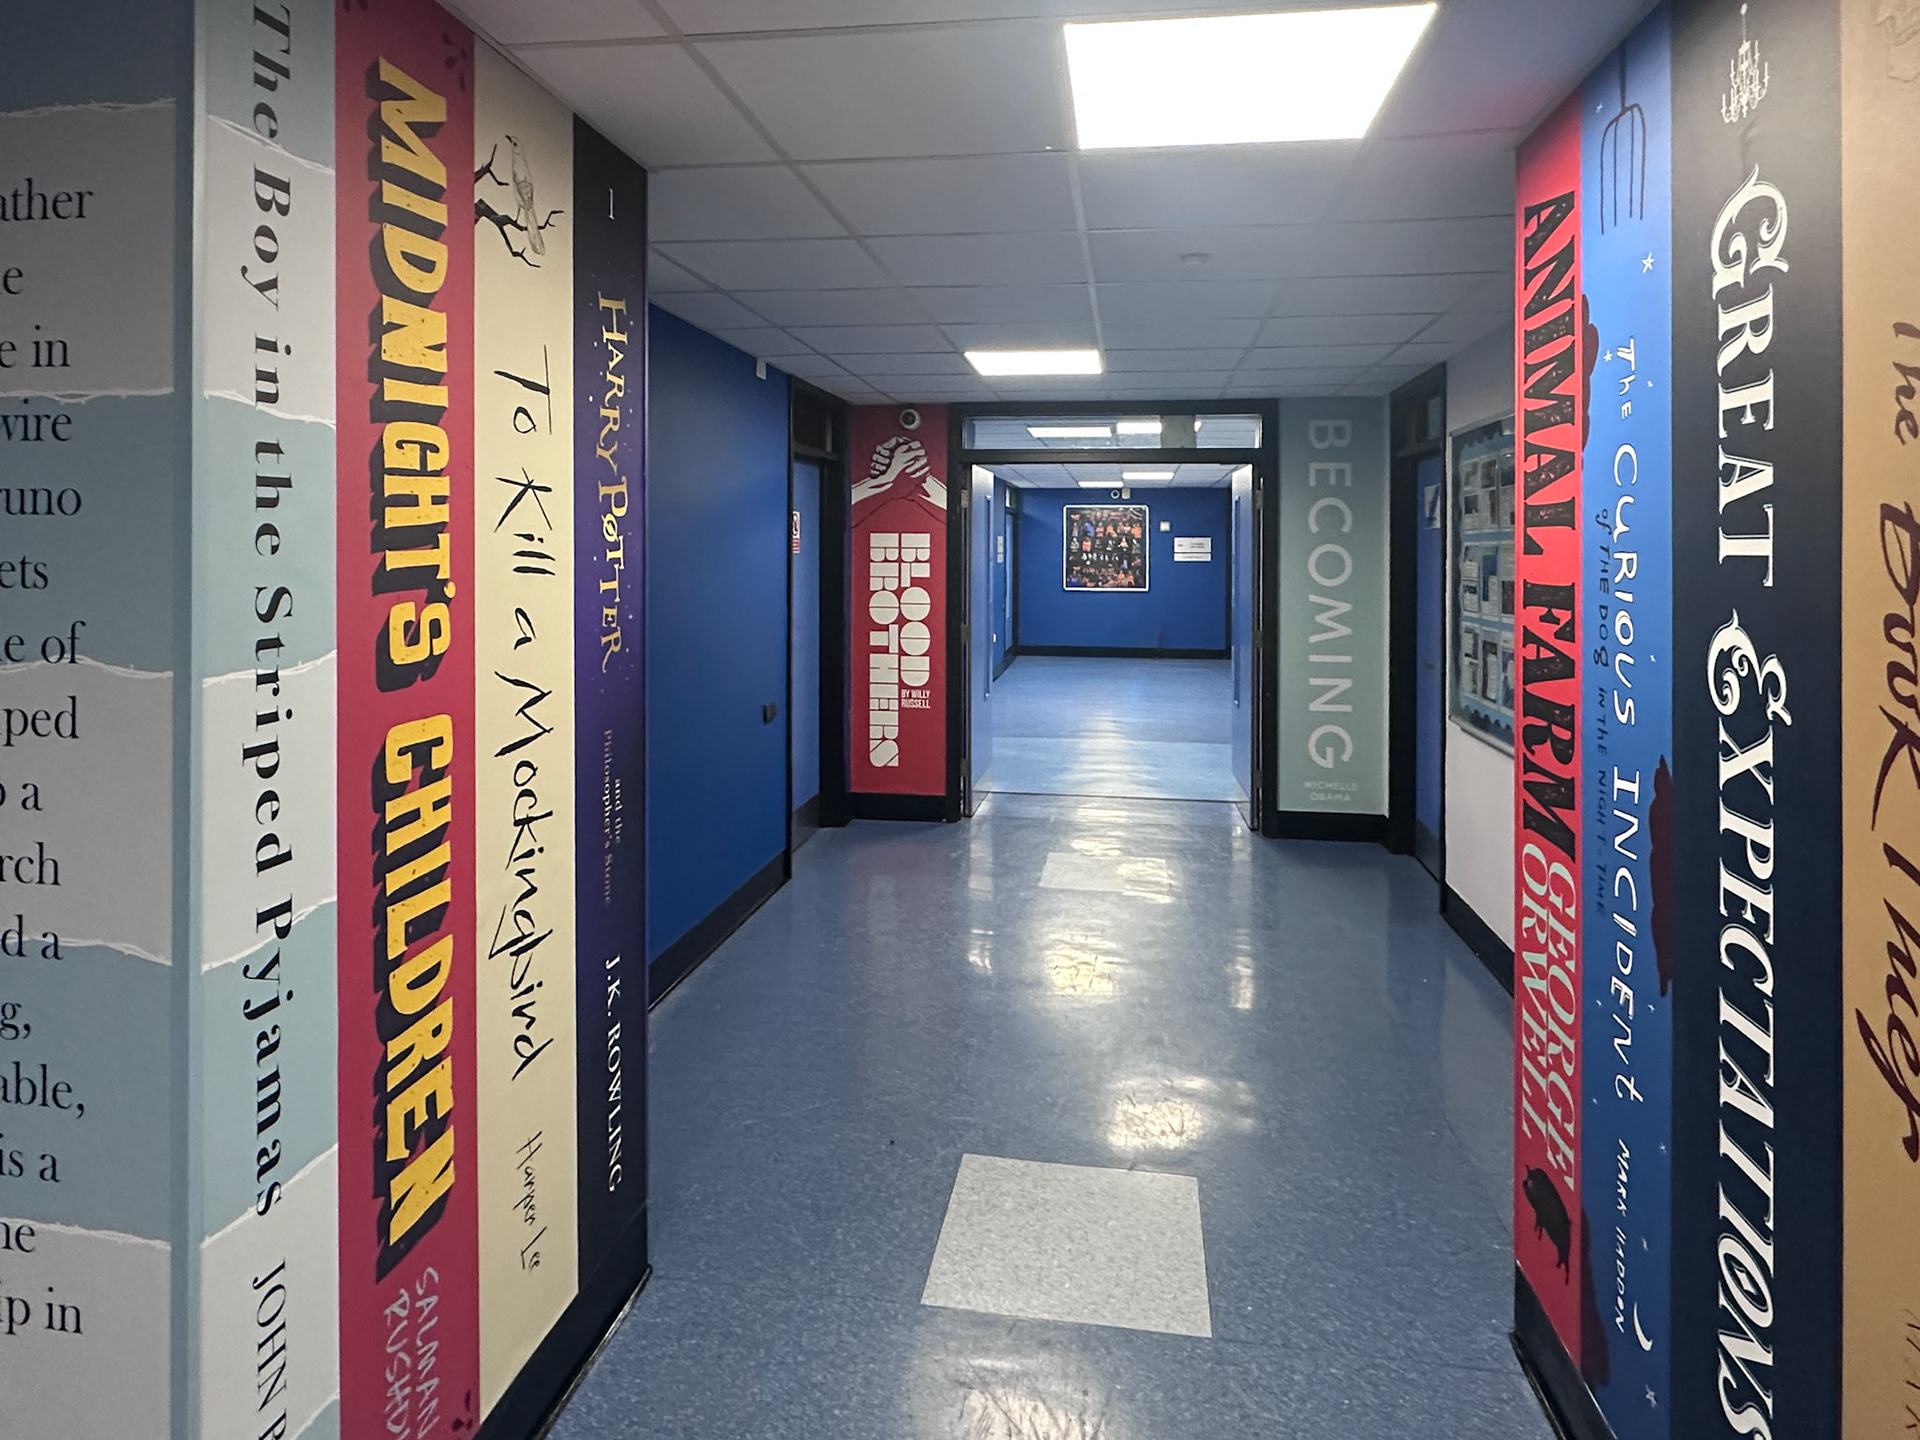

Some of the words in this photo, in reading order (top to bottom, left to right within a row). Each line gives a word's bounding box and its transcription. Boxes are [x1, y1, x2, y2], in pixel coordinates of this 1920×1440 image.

[254, 4, 290, 138] The
[241, 164, 291, 310] Boy
[31, 324, 71, 368] in
[254, 333, 292, 410] in
[376, 56, 457, 668] MIDNIGHT'S
[494, 344, 552, 435] To
[596, 291, 628, 476] HARRY
[1522, 189, 1577, 558] ANIMAL
[1710, 163, 1790, 588] GREAT
[0, 485, 83, 517] uno
[254, 437, 293, 556] the
[495, 466, 556, 576] Kill
[513, 607, 537, 650] a
[598, 475, 629, 673] POTTER
[900, 532, 931, 687] BLOOD
[1307, 418, 1354, 769] BECOMING
[41, 620, 87, 665] of
[869, 532, 899, 768] BROTHERS
[901, 689, 910, 698] BY
[911, 689, 931, 699] WILLY
[0, 695, 80, 748] ped
[242, 586, 293, 877] Striped
[901, 699, 931, 709] RUSSELL
[1522, 581, 1577, 864] FARM
[21, 782, 44, 812] a
[602, 728, 613, 850] Philosopher's
[614, 778, 623, 812] and
[614, 816, 623, 844] the
[1303, 780, 1359, 791] MICHELLE
[1310, 792, 1351, 801] OBAMA
[488, 670, 554, 1082] Mockingbird
[603, 853, 613, 905] Stone
[41, 931, 64, 960] a
[382, 713, 456, 1247] CHILDREN
[605, 952, 621, 1018] J.K.
[1521, 843, 1549, 1153] ORWELL
[242, 893, 294, 1217] Pyjamas
[1546, 861, 1577, 1193] GEORGE
[1707, 608, 1792, 1440] EXPECTATIONS
[608, 1021, 623, 1193] ROWLING
[39, 1153, 61, 1184] a
[512, 1130, 543, 1227] Harper
[1616, 1138, 1631, 1218] MARK
[520, 1226, 548, 1274] Lee
[1614, 1226, 1628, 1334] HADDON
[45, 1286, 84, 1335] in
[252, 1256, 288, 1413] JOHN
[415, 1266, 441, 1440] SALMAN
